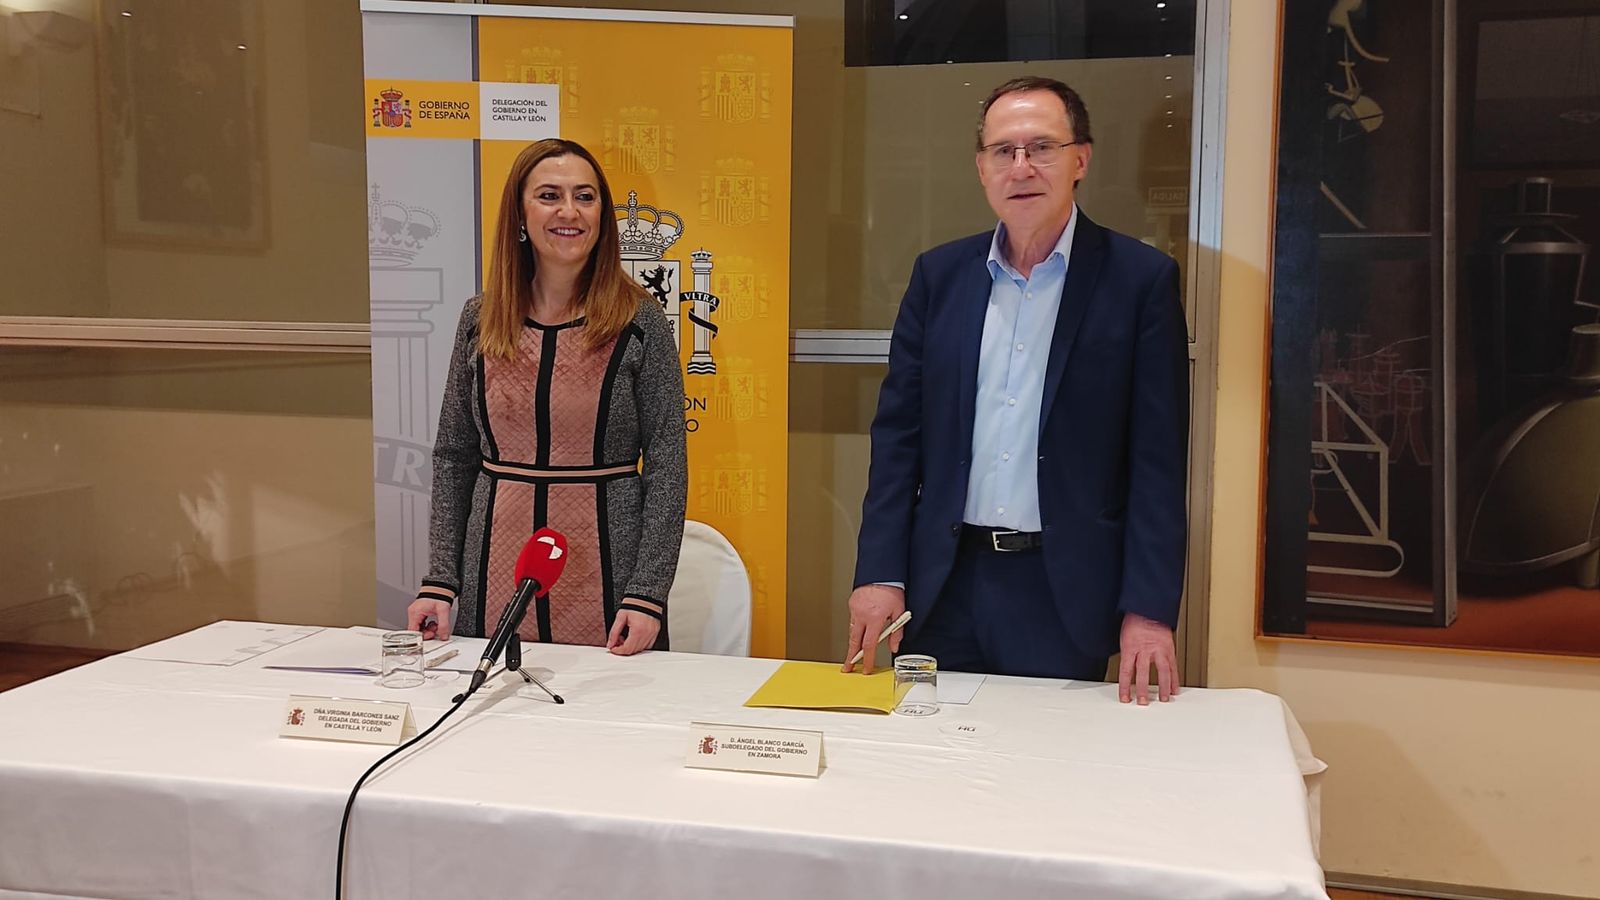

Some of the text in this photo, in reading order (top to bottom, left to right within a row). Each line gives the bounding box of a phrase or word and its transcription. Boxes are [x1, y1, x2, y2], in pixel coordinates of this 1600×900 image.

[418, 101, 470, 110] GOBIERNO
[419, 110, 470, 120] DE ESPAÑA
[684, 292, 717, 305] VLTRA
[352, 711, 382, 719] BARCONES
[362, 718, 392, 726] GOBIERNO
